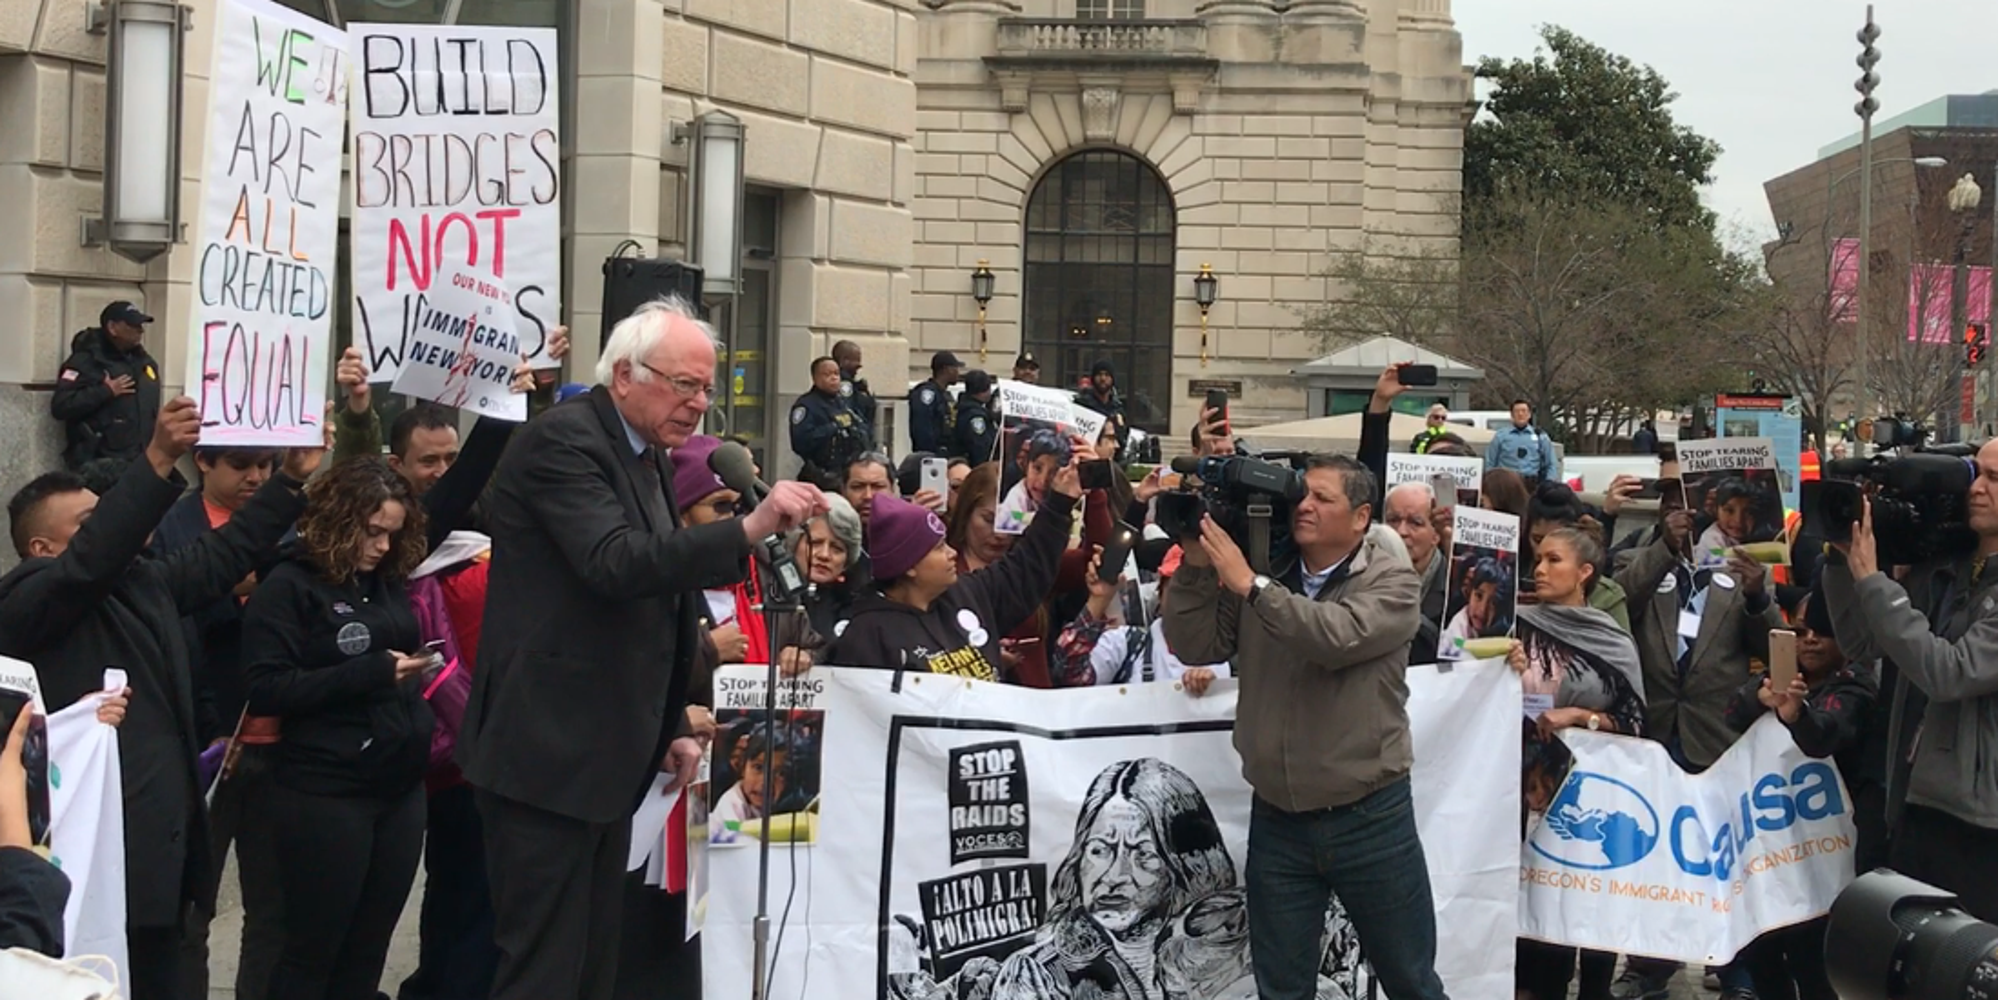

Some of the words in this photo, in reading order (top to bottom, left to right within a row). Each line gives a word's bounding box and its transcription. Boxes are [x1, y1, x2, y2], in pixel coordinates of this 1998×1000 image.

[253, 16, 314, 104] WE
[364, 35, 547, 118] BUILD
[229, 100, 321, 208] ARE
[356, 128, 557, 208] BRIDGES
[225, 184, 309, 262] ALL
[386, 208, 520, 291] NOT
[199, 243, 328, 320] CREATED
[453, 272, 474, 291] OUR
[476, 281, 499, 300] NEW
[199, 320, 317, 431] EQUAL
[1003, 389, 1028, 402] STOP
[1010, 402, 1048, 418] FAMILIES
[1681, 449, 1713, 461] STOP
[1716, 445, 1769, 457] TEARING
[1688, 456, 1735, 471] FAMILIES
[1736, 456, 1765, 468] APART
[1391, 461, 1421, 472] STOP
[1424, 465, 1477, 477] TEARING
[1457, 516, 1478, 530] STOP
[1481, 522, 1517, 537] TEARING
[1461, 529, 1493, 546] FAMILIES
[1493, 534, 1514, 549] APART
[719, 677, 757, 691] STOP
[760, 679, 824, 693] TARING
[780, 692, 815, 707] APART
[959, 748, 1016, 776] STOP
[967, 777, 1010, 801] THE
[952, 803, 1025, 830] RAIDS
[1670, 762, 1845, 881] Causa
[955, 832, 1006, 848] VOCES
[991, 871, 1003, 902] A
[1009, 868, 1032, 899] LA
[1608, 880, 1706, 906] IMMIGRANT
[931, 898, 1038, 951] POLIMIGRA!
